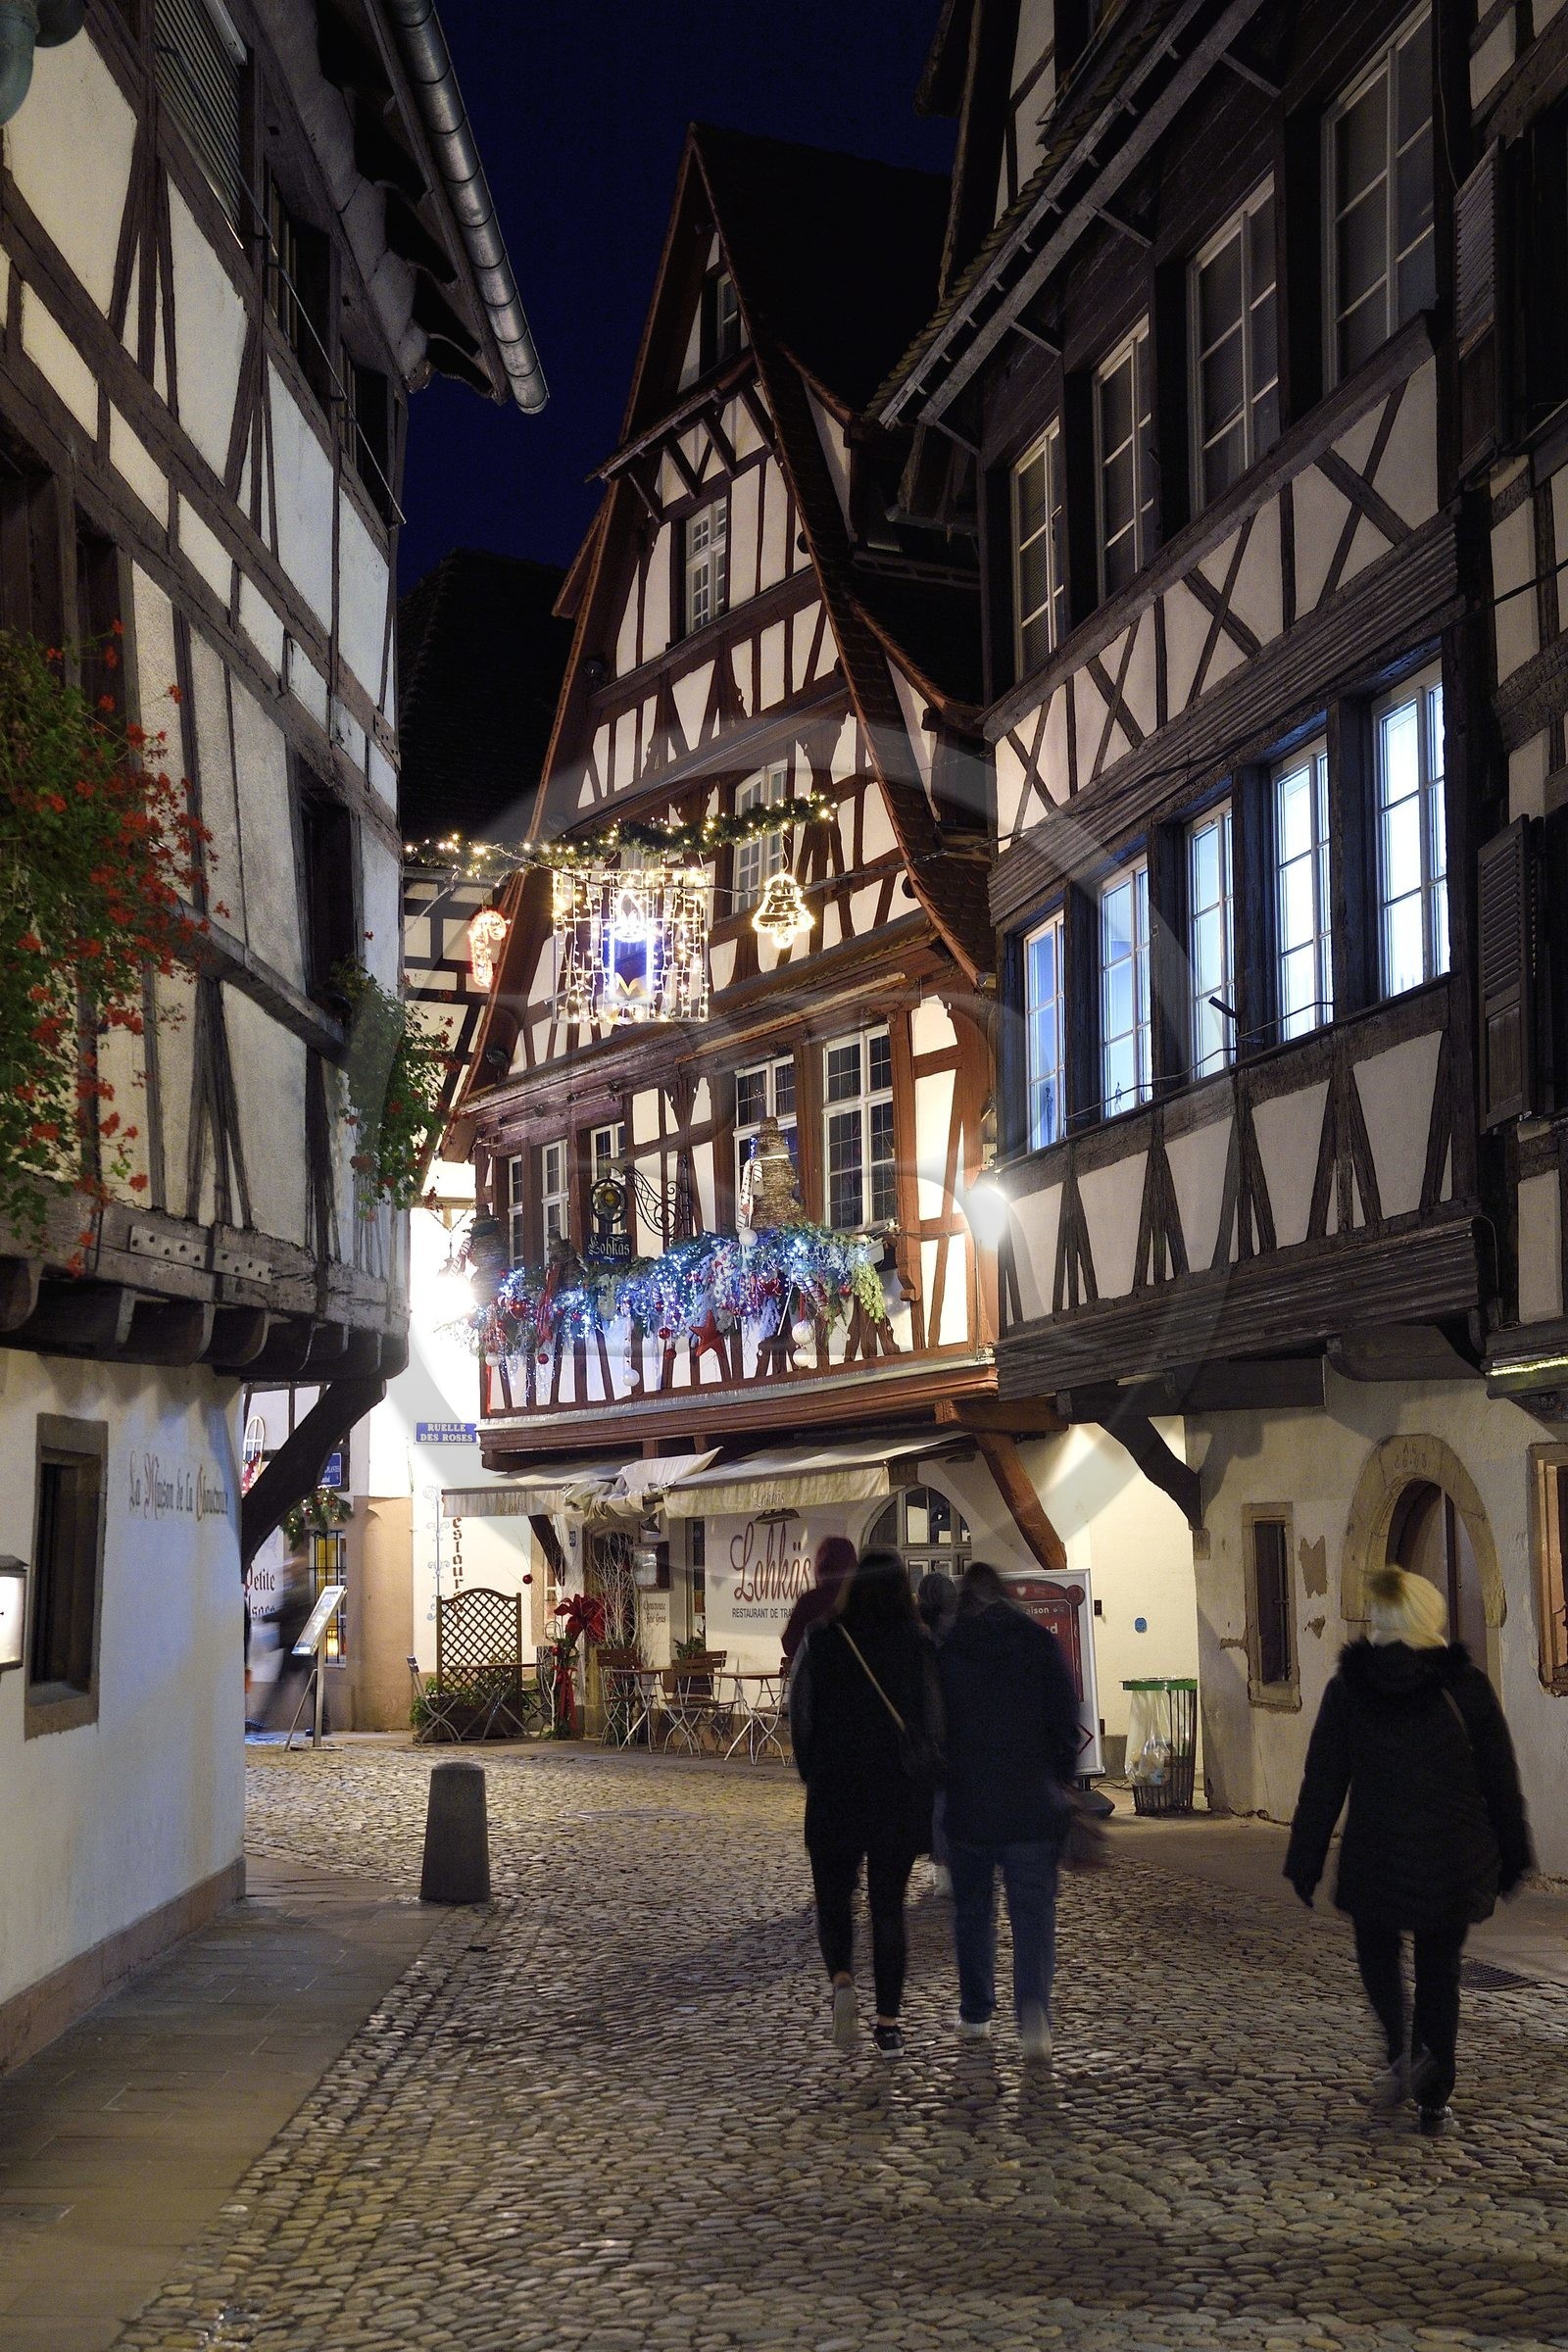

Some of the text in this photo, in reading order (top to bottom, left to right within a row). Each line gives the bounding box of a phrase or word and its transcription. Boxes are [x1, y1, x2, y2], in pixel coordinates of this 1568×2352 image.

[427, 1423, 466, 1432] RUELLE
[419, 1433, 473, 1443] DES ROSES
[731, 1608, 769, 1618] RESTAURANT
[770, 1608, 778, 1618] DE
